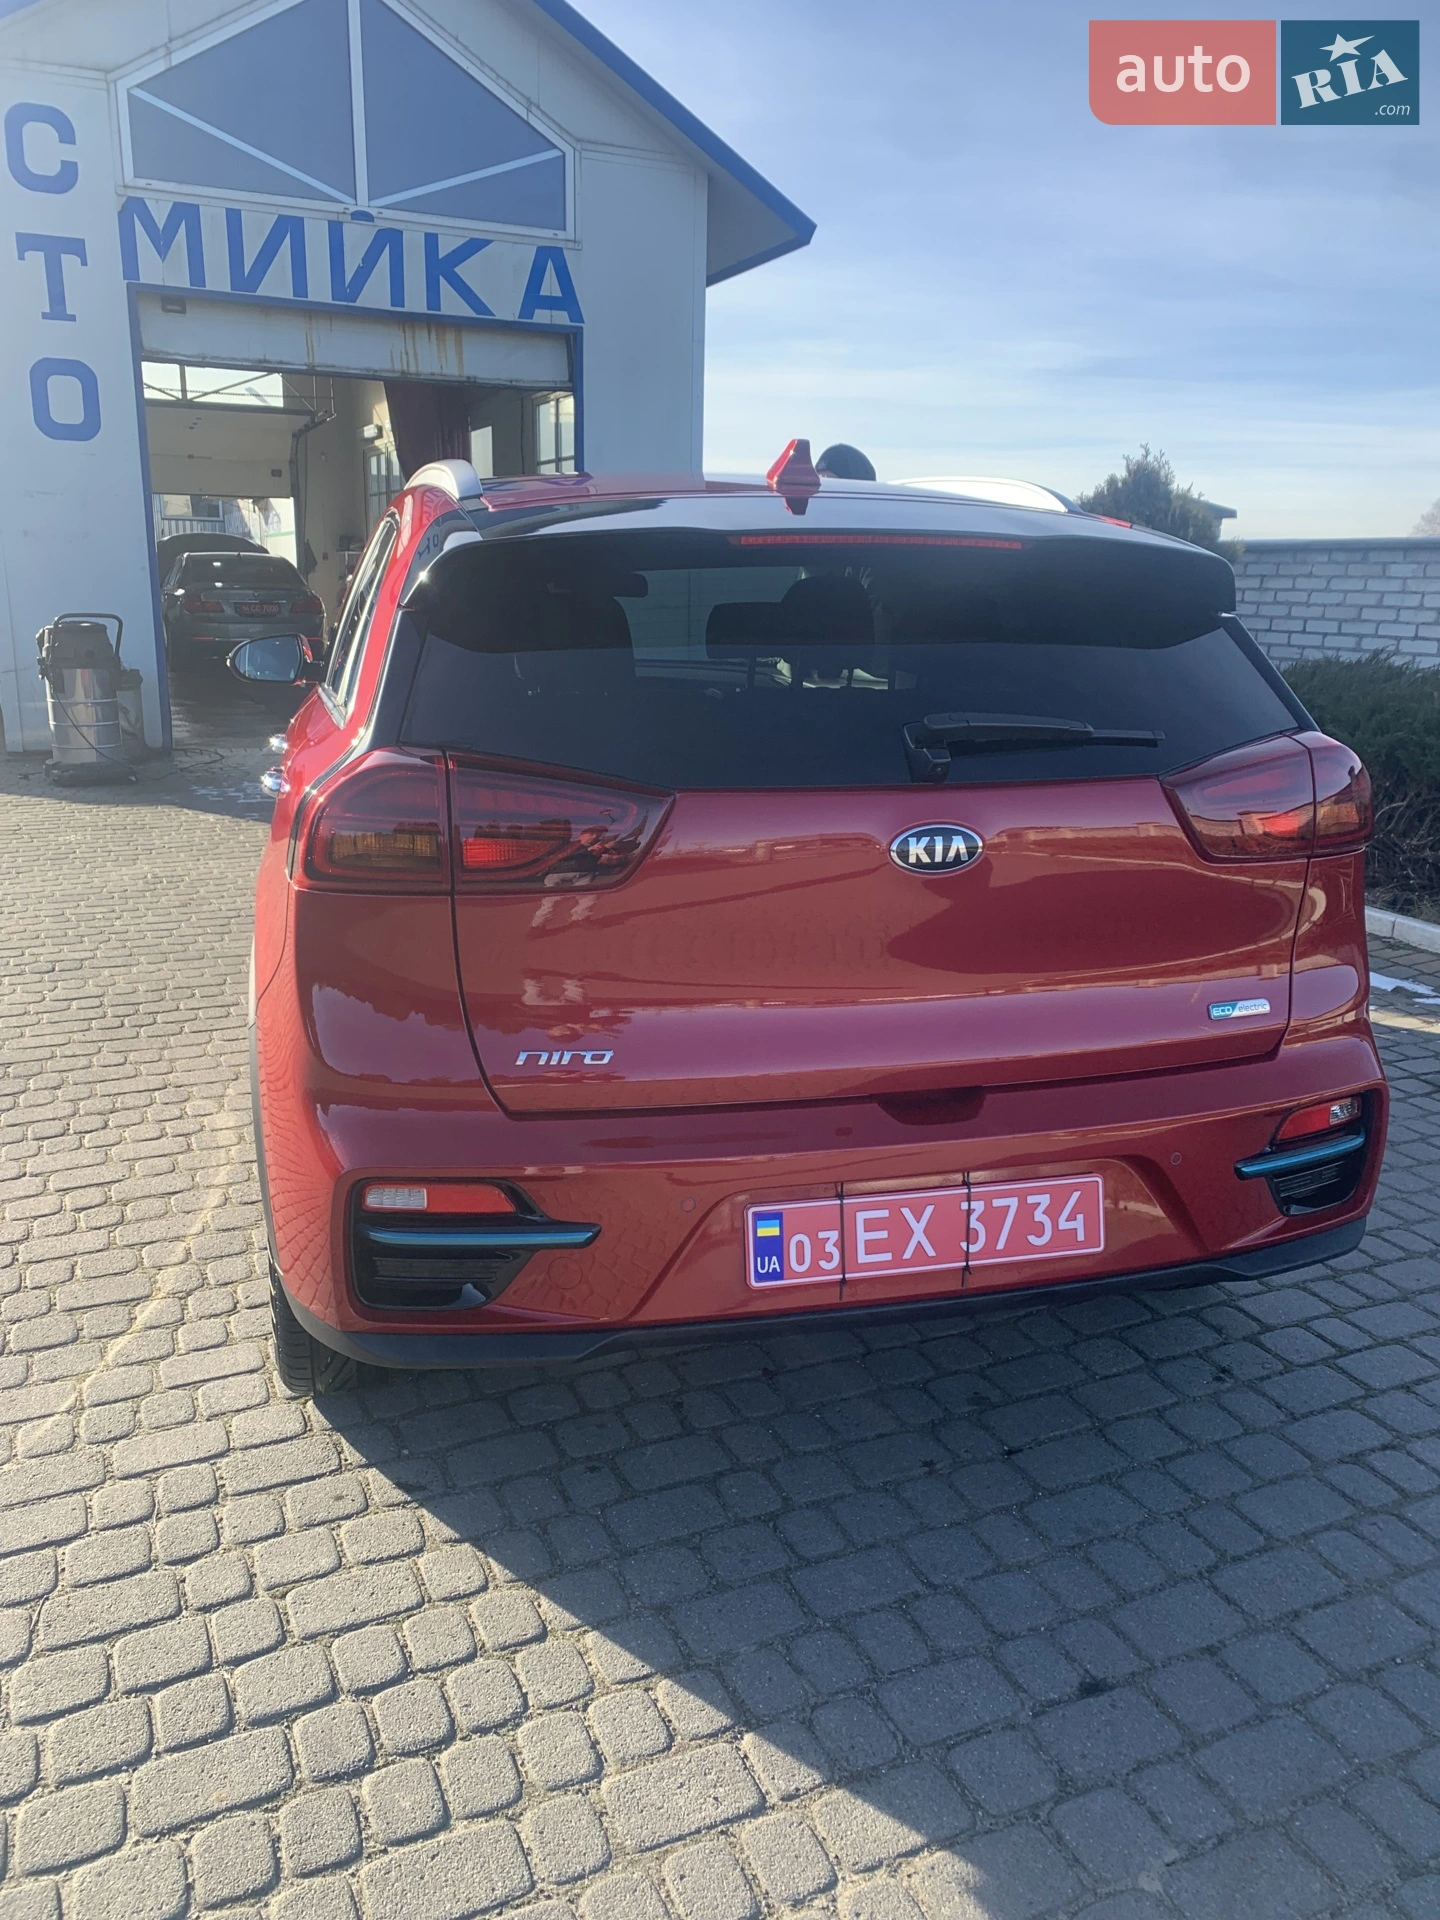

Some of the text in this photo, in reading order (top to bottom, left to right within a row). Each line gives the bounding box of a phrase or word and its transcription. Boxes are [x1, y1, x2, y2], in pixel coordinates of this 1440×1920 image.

[4, 102, 102, 442] СТО
[117, 196, 586, 324] МИЙКА
[907, 835, 969, 863] KIA
[1238, 1002, 1267, 1012] electric
[788, 1190, 1085, 1273] 03 EX 3734
[756, 1255, 781, 1274] UA
